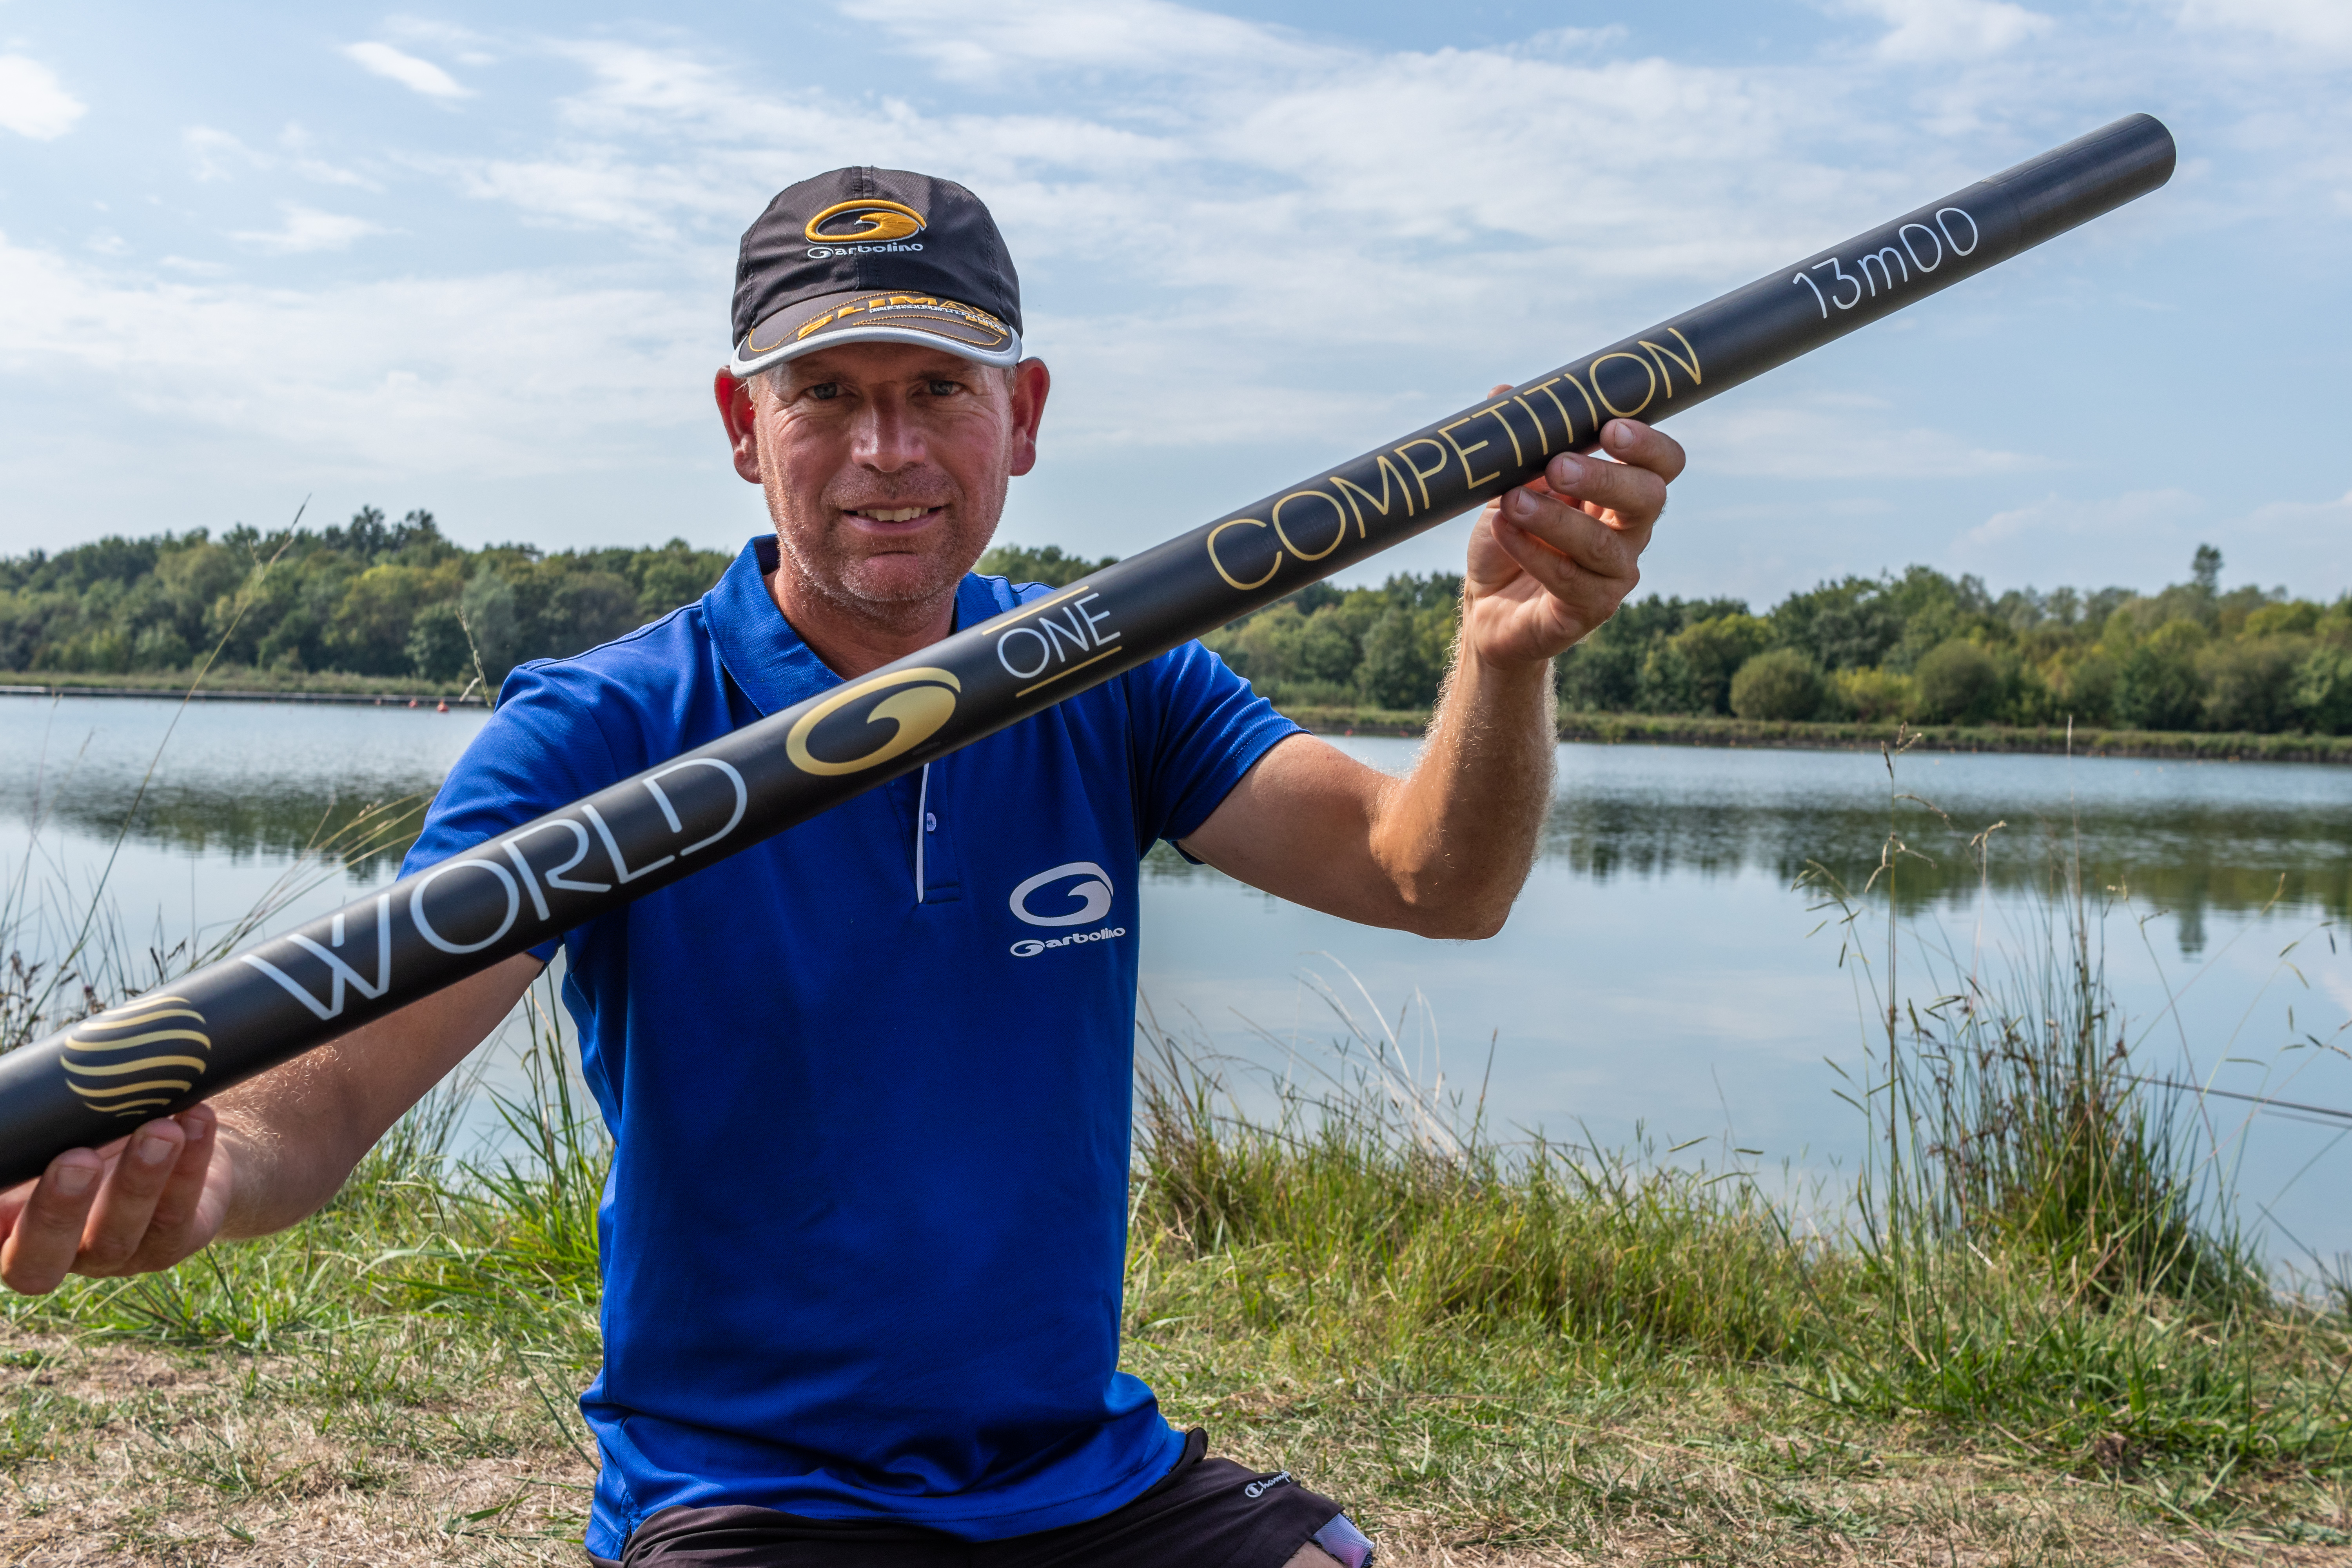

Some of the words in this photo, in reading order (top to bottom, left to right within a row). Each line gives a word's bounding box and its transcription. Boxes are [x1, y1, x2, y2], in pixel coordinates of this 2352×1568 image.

[807, 242, 923, 259] Garbolino
[241, 758, 747, 1020] WORLD
[997, 593, 1120, 679] ONE
[1207, 328, 1701, 590] COMPETITION
[1793, 207, 1978, 318] 13m00
[1010, 927, 1125, 957] Garbolino
